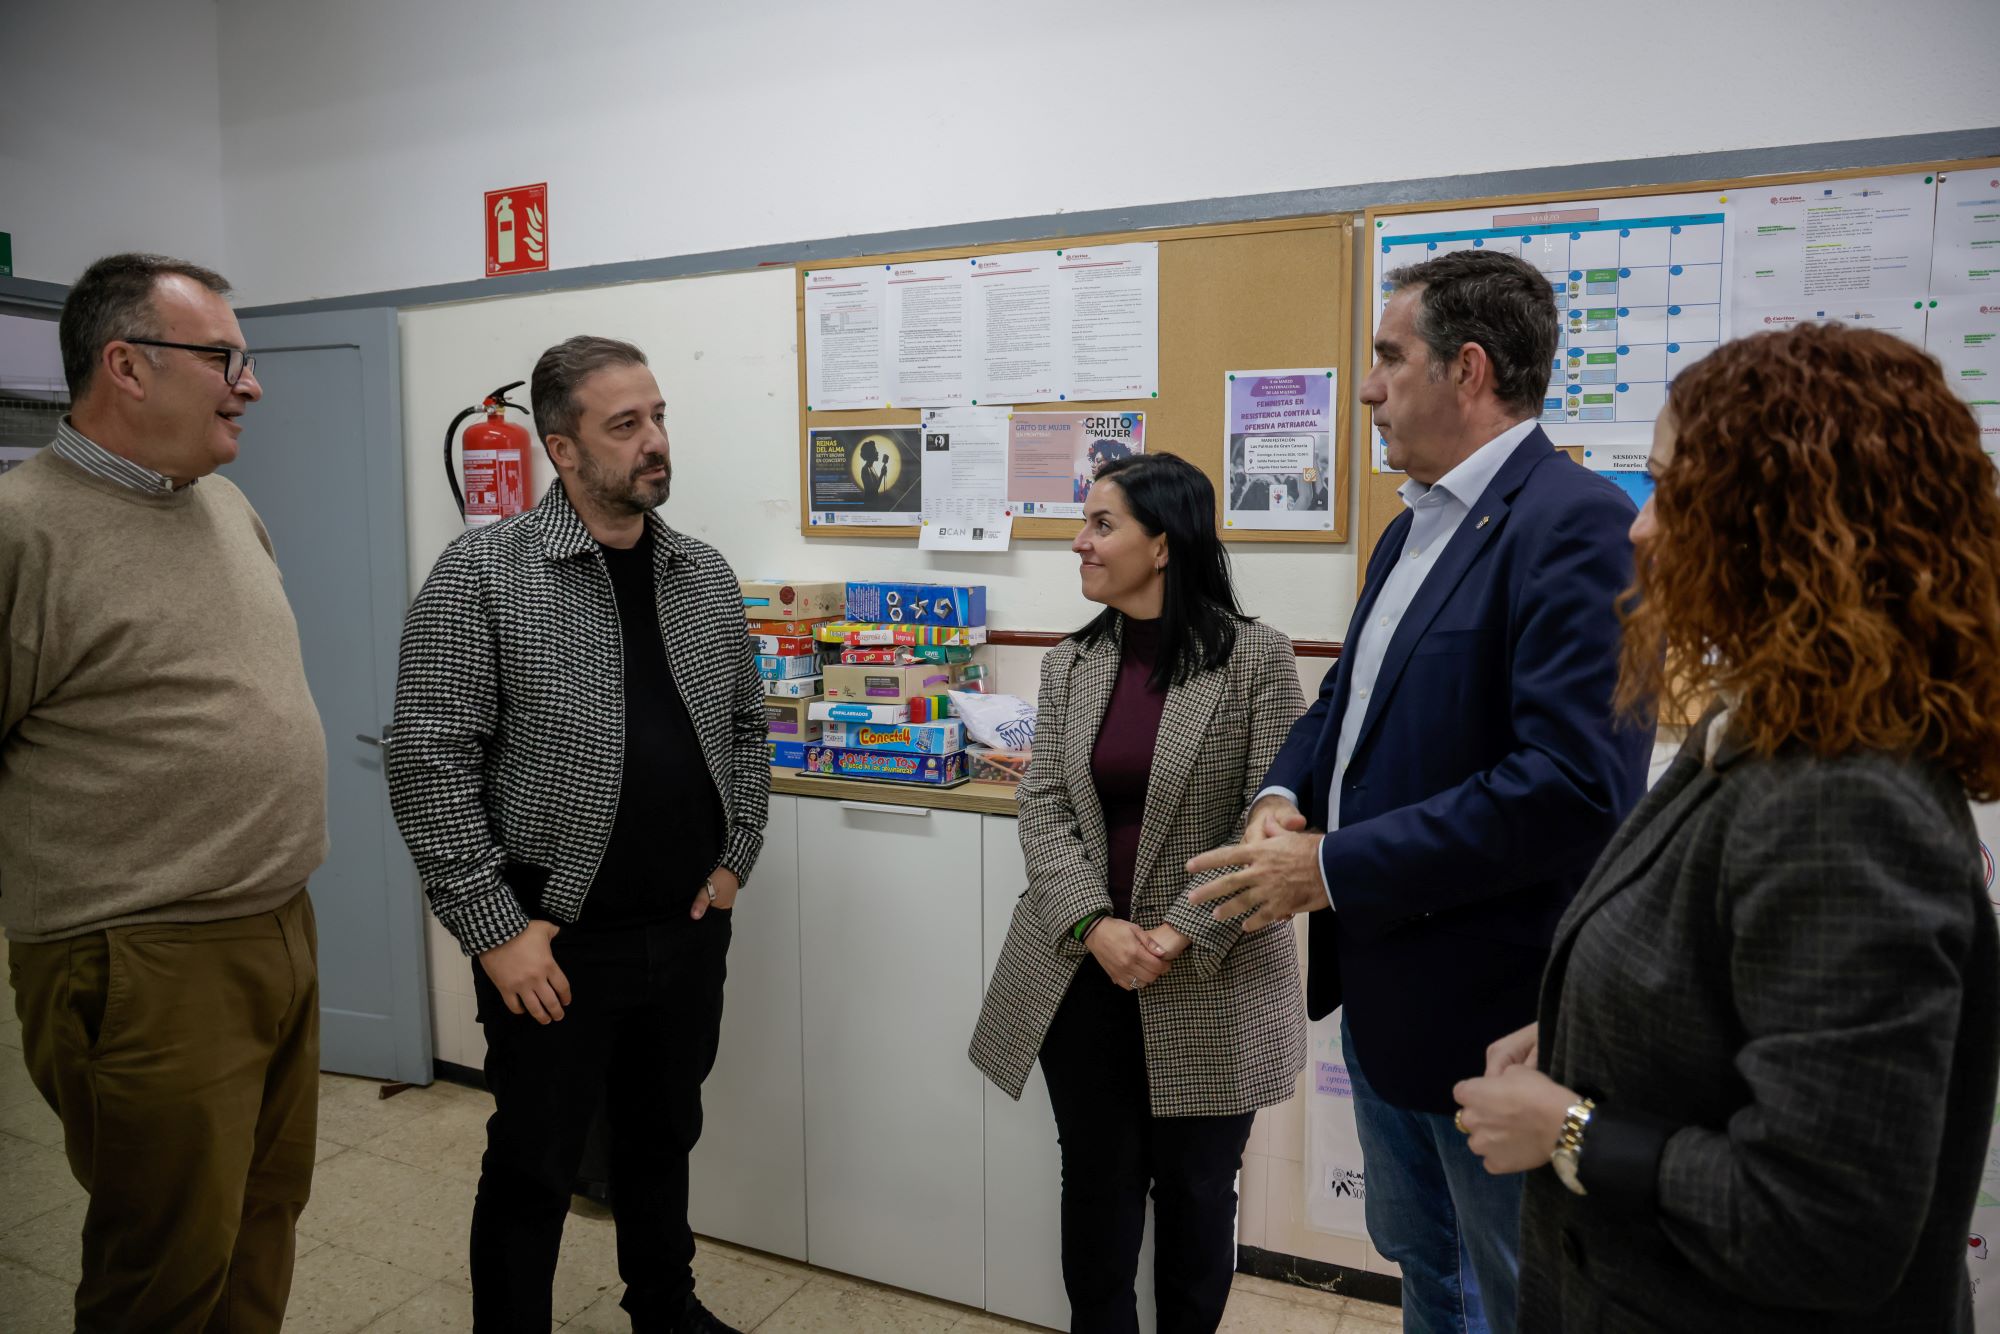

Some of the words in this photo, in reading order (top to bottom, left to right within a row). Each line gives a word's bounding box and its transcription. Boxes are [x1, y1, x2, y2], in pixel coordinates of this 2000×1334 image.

[1531, 215, 1560, 223] MARZO
[1256, 399, 1293, 407] FEMINISTAS
[1240, 411, 1282, 420] RESISTENCIA
[1283, 409, 1310, 417] CONTRA
[1085, 417, 1132, 429] GRITO
[1244, 423, 1275, 431] OFENSIVA
[1277, 420, 1318, 429] PATRIARCAL
[1094, 429, 1131, 438] MUJER
[863, 653, 875, 662] UNO
[832, 710, 869, 718] EMPALABRADOS
